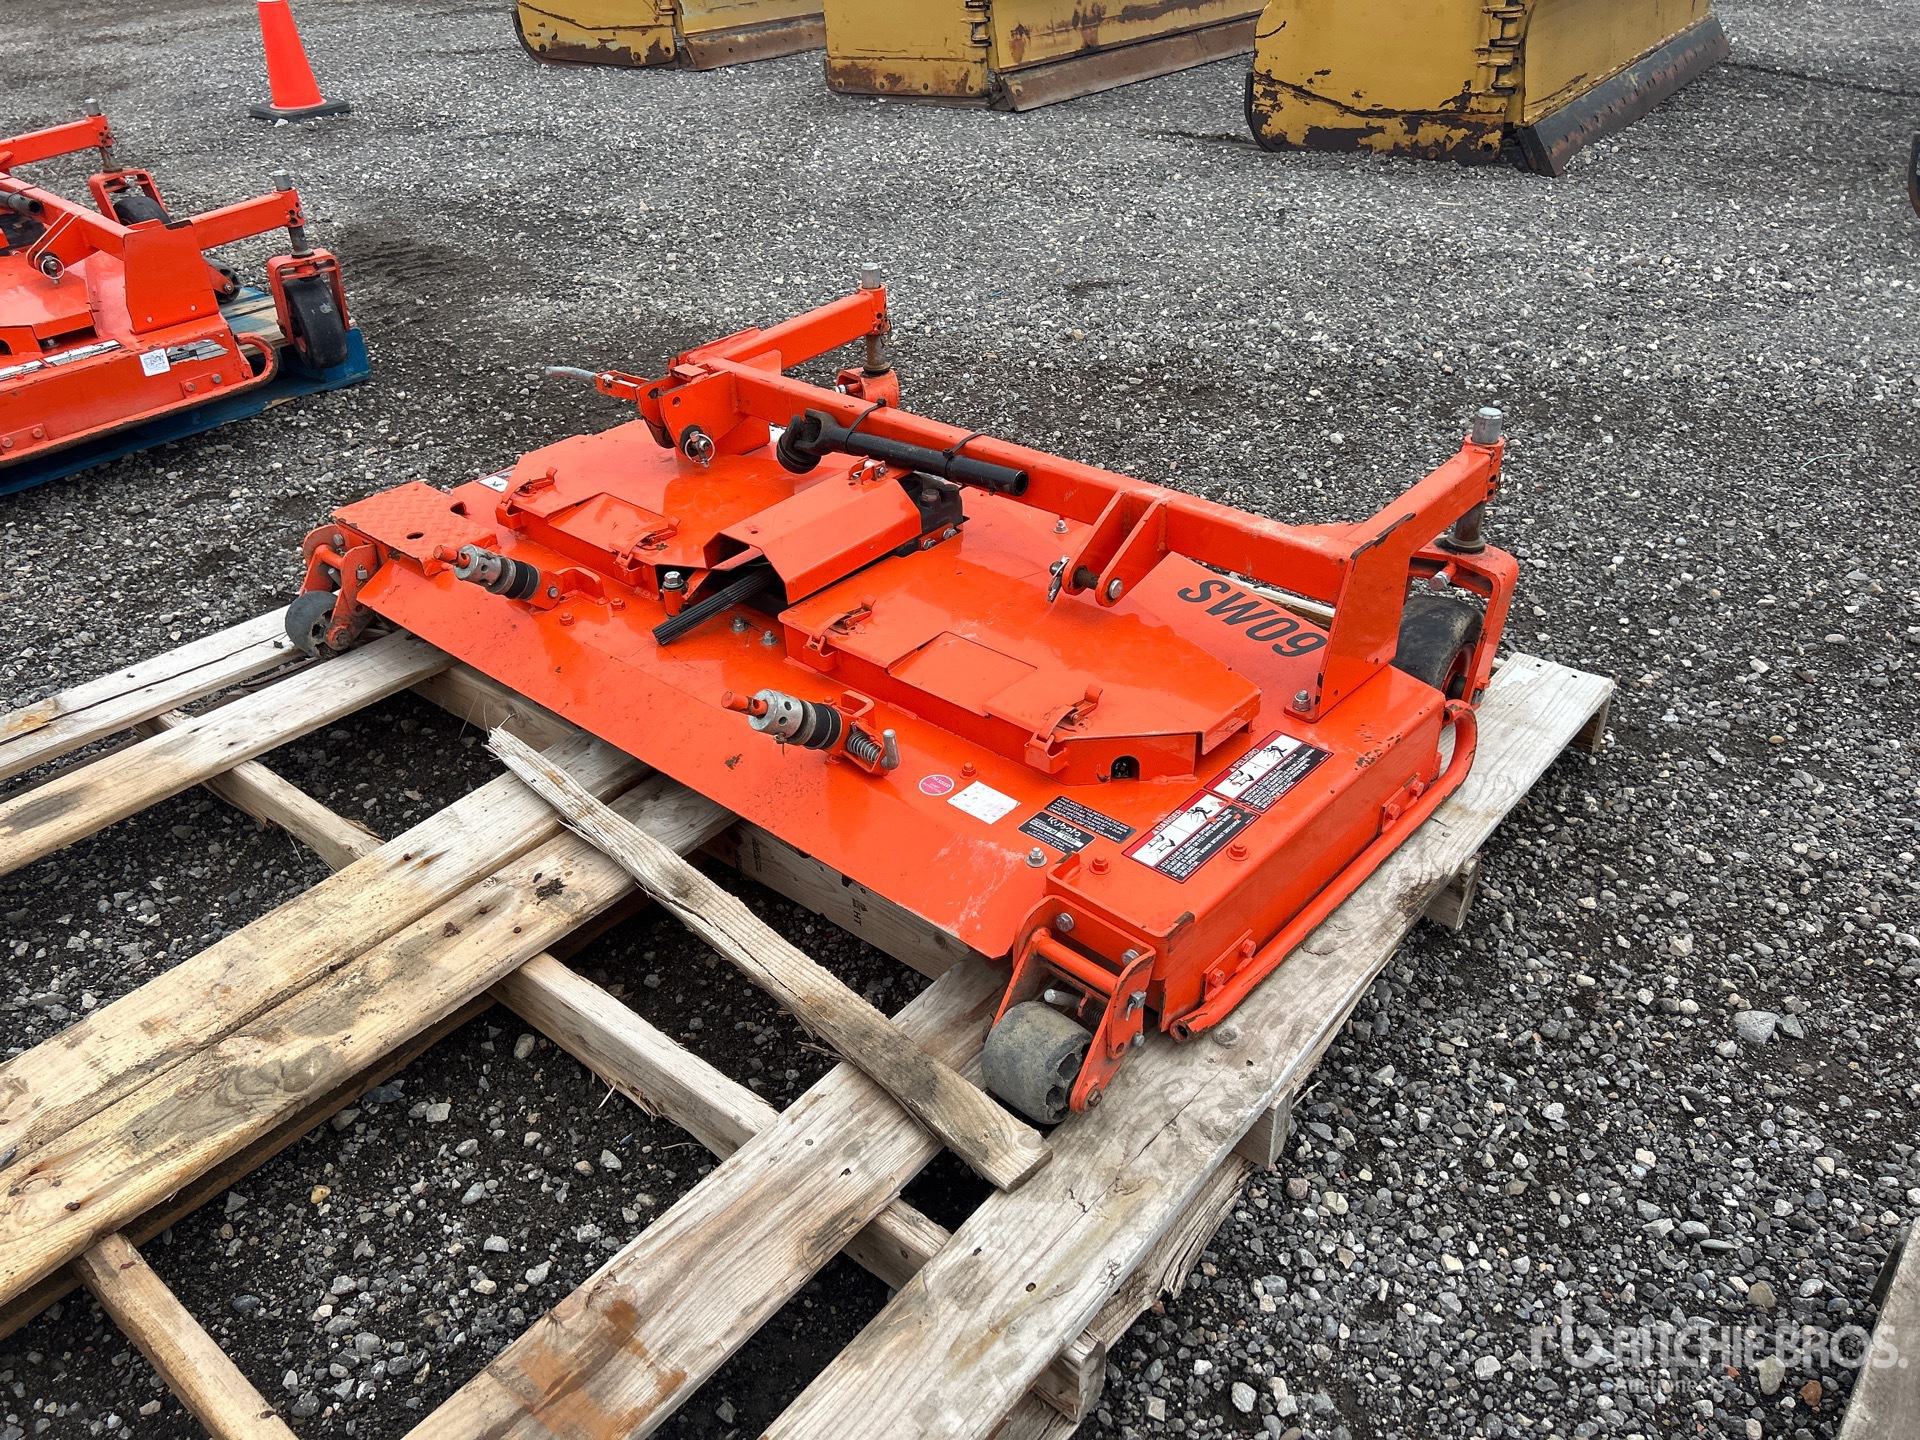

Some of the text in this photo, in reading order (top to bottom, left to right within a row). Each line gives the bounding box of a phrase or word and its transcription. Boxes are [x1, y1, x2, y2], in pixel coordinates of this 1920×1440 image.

[1232, 747, 1260, 768] PELIGRO
[1047, 817, 1081, 837] Kubota
[1154, 809, 1184, 831] DANGER
